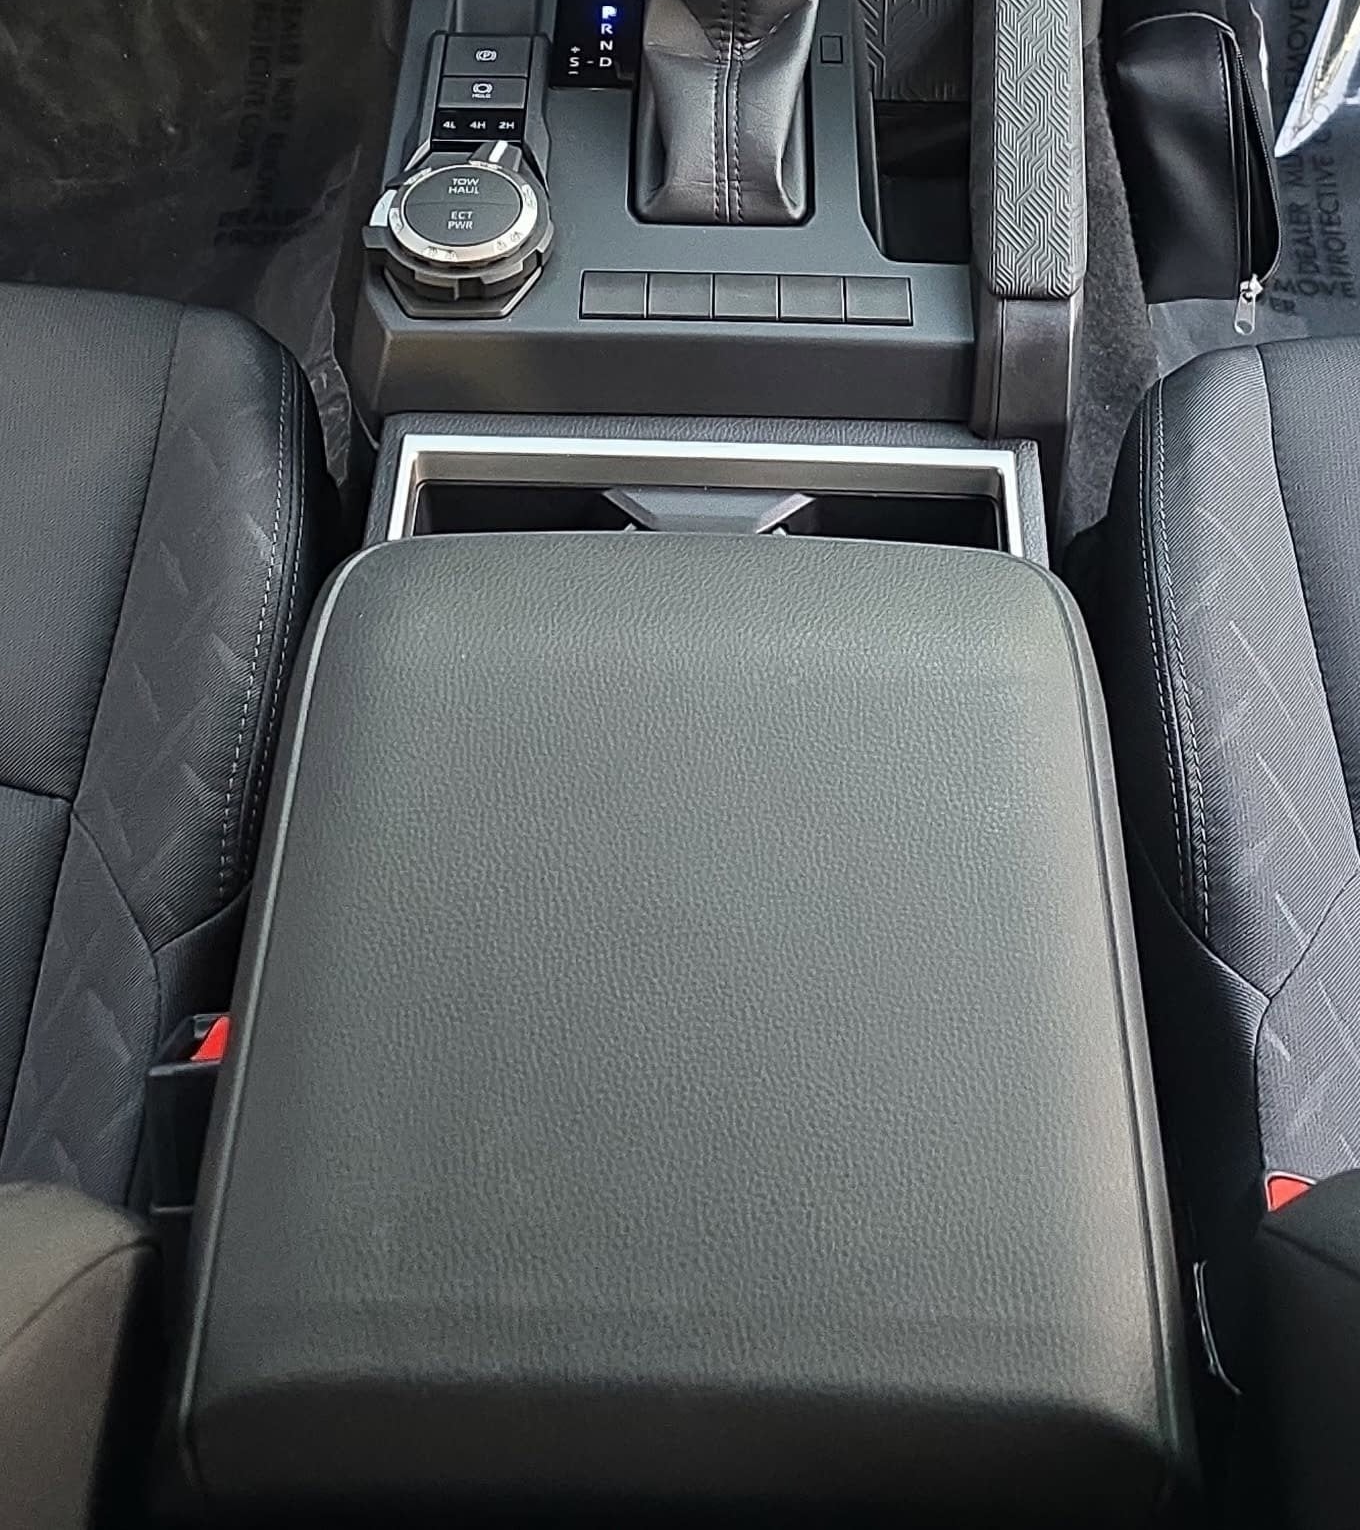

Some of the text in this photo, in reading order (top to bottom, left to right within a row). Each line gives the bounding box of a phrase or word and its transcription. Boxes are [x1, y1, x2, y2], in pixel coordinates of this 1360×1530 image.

[601, 5, 618, 20] P
[601, 23, 614, 35] R
[600, 40, 613, 51] N
[569, 56, 580, 68] S
[599, 56, 613, 68] D
[443, 121, 457, 130] 4L
[469, 121, 487, 130] 4H
[498, 121, 516, 130] 2H
[452, 177, 480, 186] TOW
[448, 185, 480, 195] HAUL
[450, 211, 473, 220] ECT
[447, 220, 474, 230] PWR
